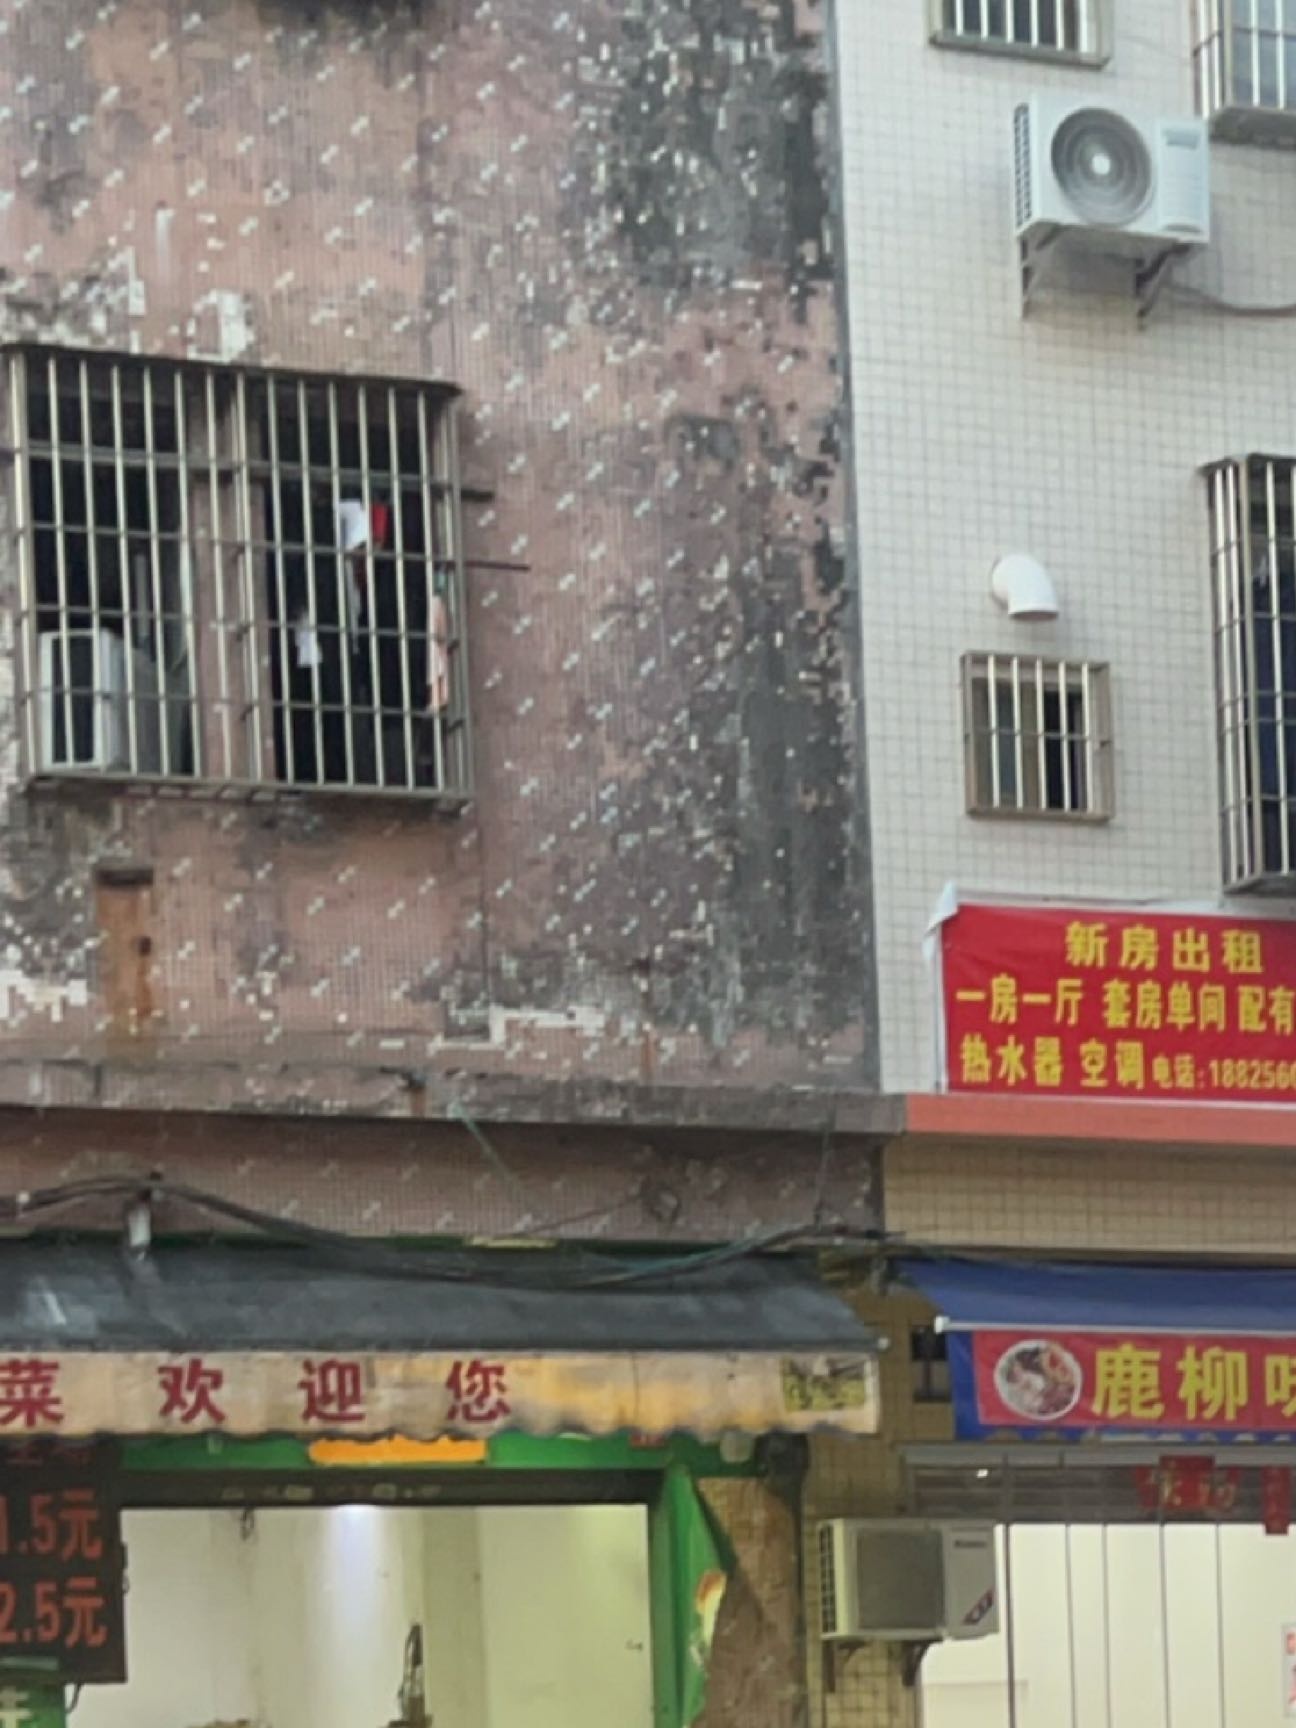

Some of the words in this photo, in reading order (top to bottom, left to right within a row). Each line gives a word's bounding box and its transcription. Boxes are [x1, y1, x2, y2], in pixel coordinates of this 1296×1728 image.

[1065, 920, 1264, 975] 新房出租
[956, 973, 1084, 1027] 一房一厅
[1103, 977, 1226, 1032] 套房单间
[960, 1034, 1065, 1087] 热水器
[1079, 1038, 1146, 1089] 空调
